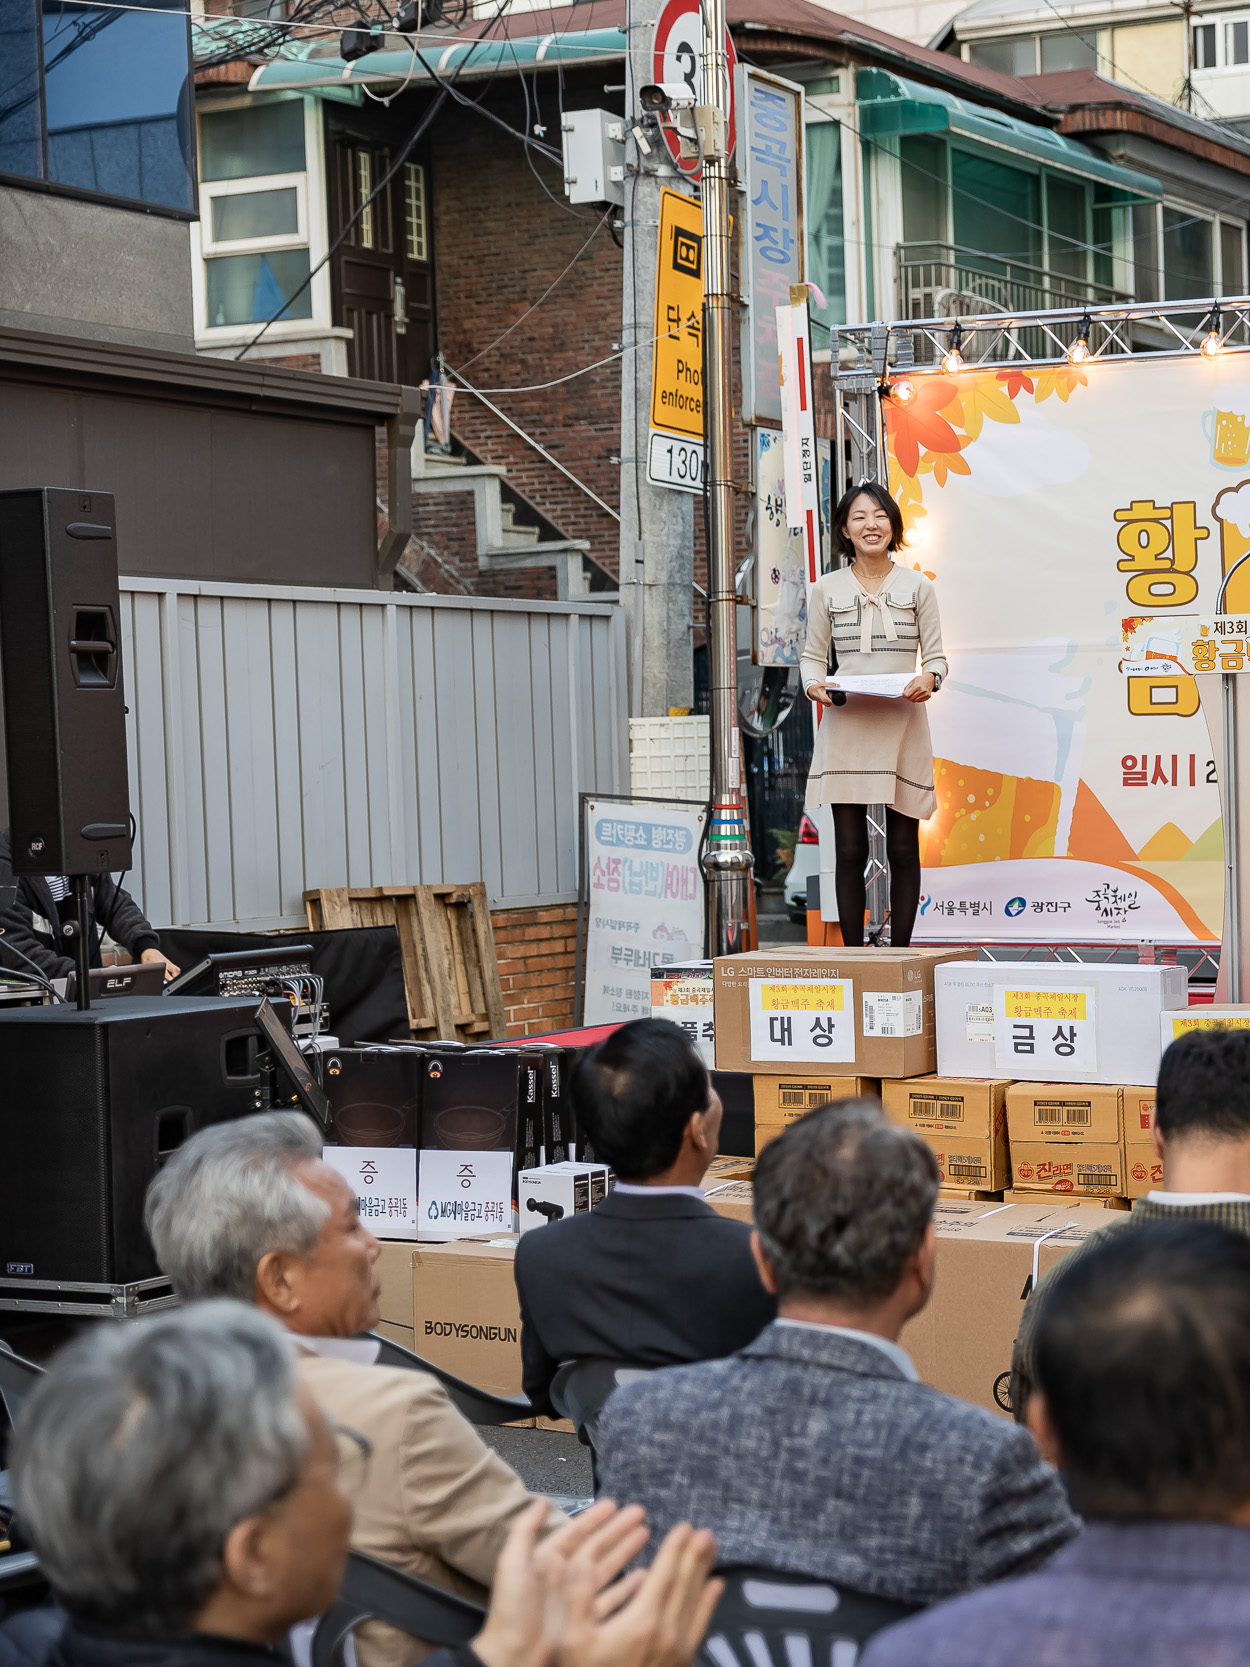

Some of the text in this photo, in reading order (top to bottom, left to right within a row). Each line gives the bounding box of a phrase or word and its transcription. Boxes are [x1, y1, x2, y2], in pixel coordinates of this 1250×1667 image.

[750, 87, 795, 265] 중곡시장
[661, 389, 703, 415] enforce
[666, 445, 706, 483] 130
[801, 437, 811, 484] 일단정지
[1213, 617, 1248, 636] 제3회
[1121, 754, 1178, 788] 일시
[933, 900, 993, 917] 서울특별시
[1030, 901, 1072, 914] 광진구
[721, 966, 735, 977] LG
[738, 967, 765, 978] 스마트
[766, 967, 793, 978] 인버터
[914, 970, 921, 979] LG
[106, 977, 132, 989] ELF
[768, 984, 837, 994] 제3회 중곡제일시장
[771, 998, 836, 1011] 황금맥주 축제
[1012, 991, 1079, 1003] 제3회 중곡제일시장
[1013, 1006, 1078, 1019] 황금맥주 축제
[1180, 1018, 1200, 1028] 제3회
[527, 1069, 535, 1103] Kassel
[551, 1064, 559, 1098] Kassel
[358, 1160, 379, 1185] 증
[456, 1164, 477, 1189] 증
[1036, 1161, 1074, 1180] 진라면
[387, 1197, 408, 1218] 중곡1동
[440, 1200, 505, 1223] MG새마을금고 중곡1동
[9, 1264, 31, 1272] FBT
[424, 1320, 517, 1343] BODYSONGUN
